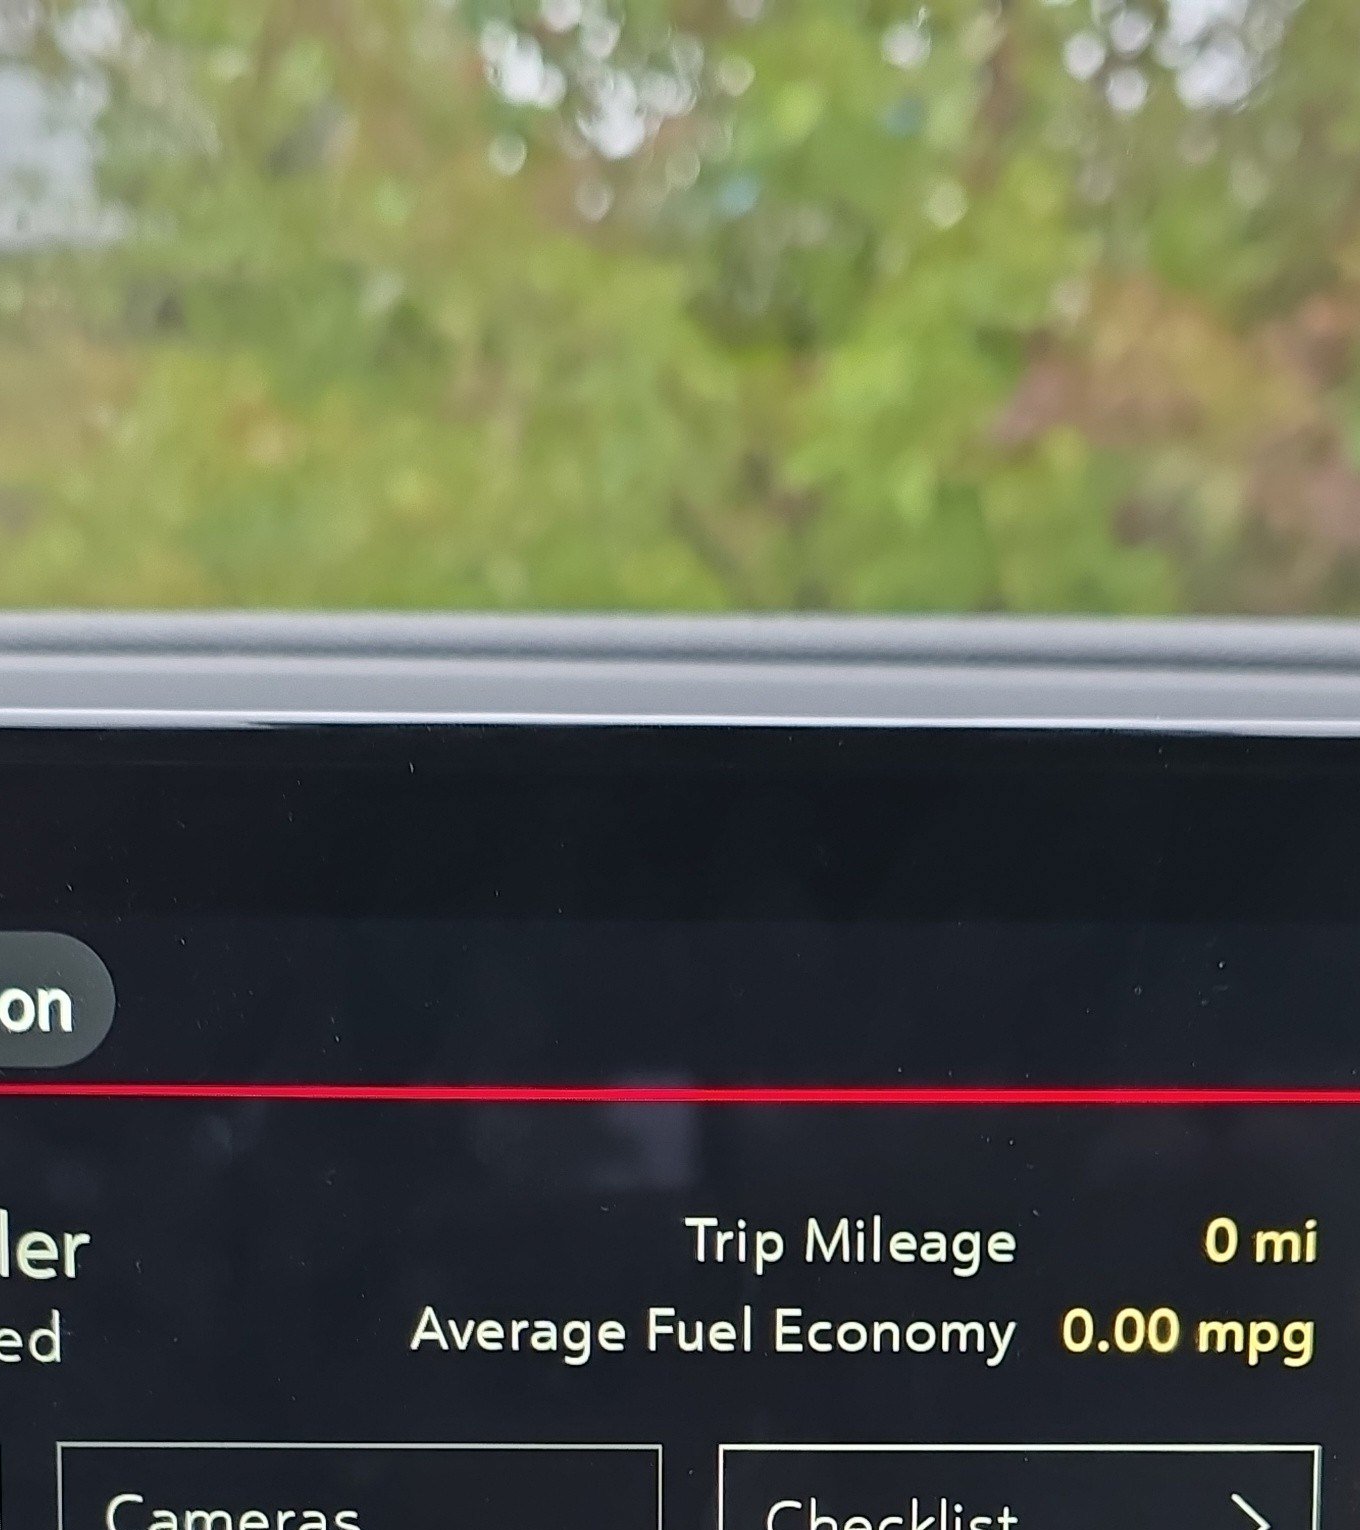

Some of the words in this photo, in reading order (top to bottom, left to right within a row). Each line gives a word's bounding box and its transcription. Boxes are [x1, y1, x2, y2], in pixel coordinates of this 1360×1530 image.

[684, 1217, 784, 1276] Trip
[805, 1214, 1016, 1278] Mileage
[1205, 1217, 1238, 1263] 0
[1255, 1219, 1317, 1263] mi
[409, 1305, 626, 1366] Average
[648, 1304, 751, 1352] Fuel
[775, 1307, 1017, 1367] Economy
[1062, 1307, 1180, 1353] 0.00
[1197, 1321, 1314, 1368] mpg
